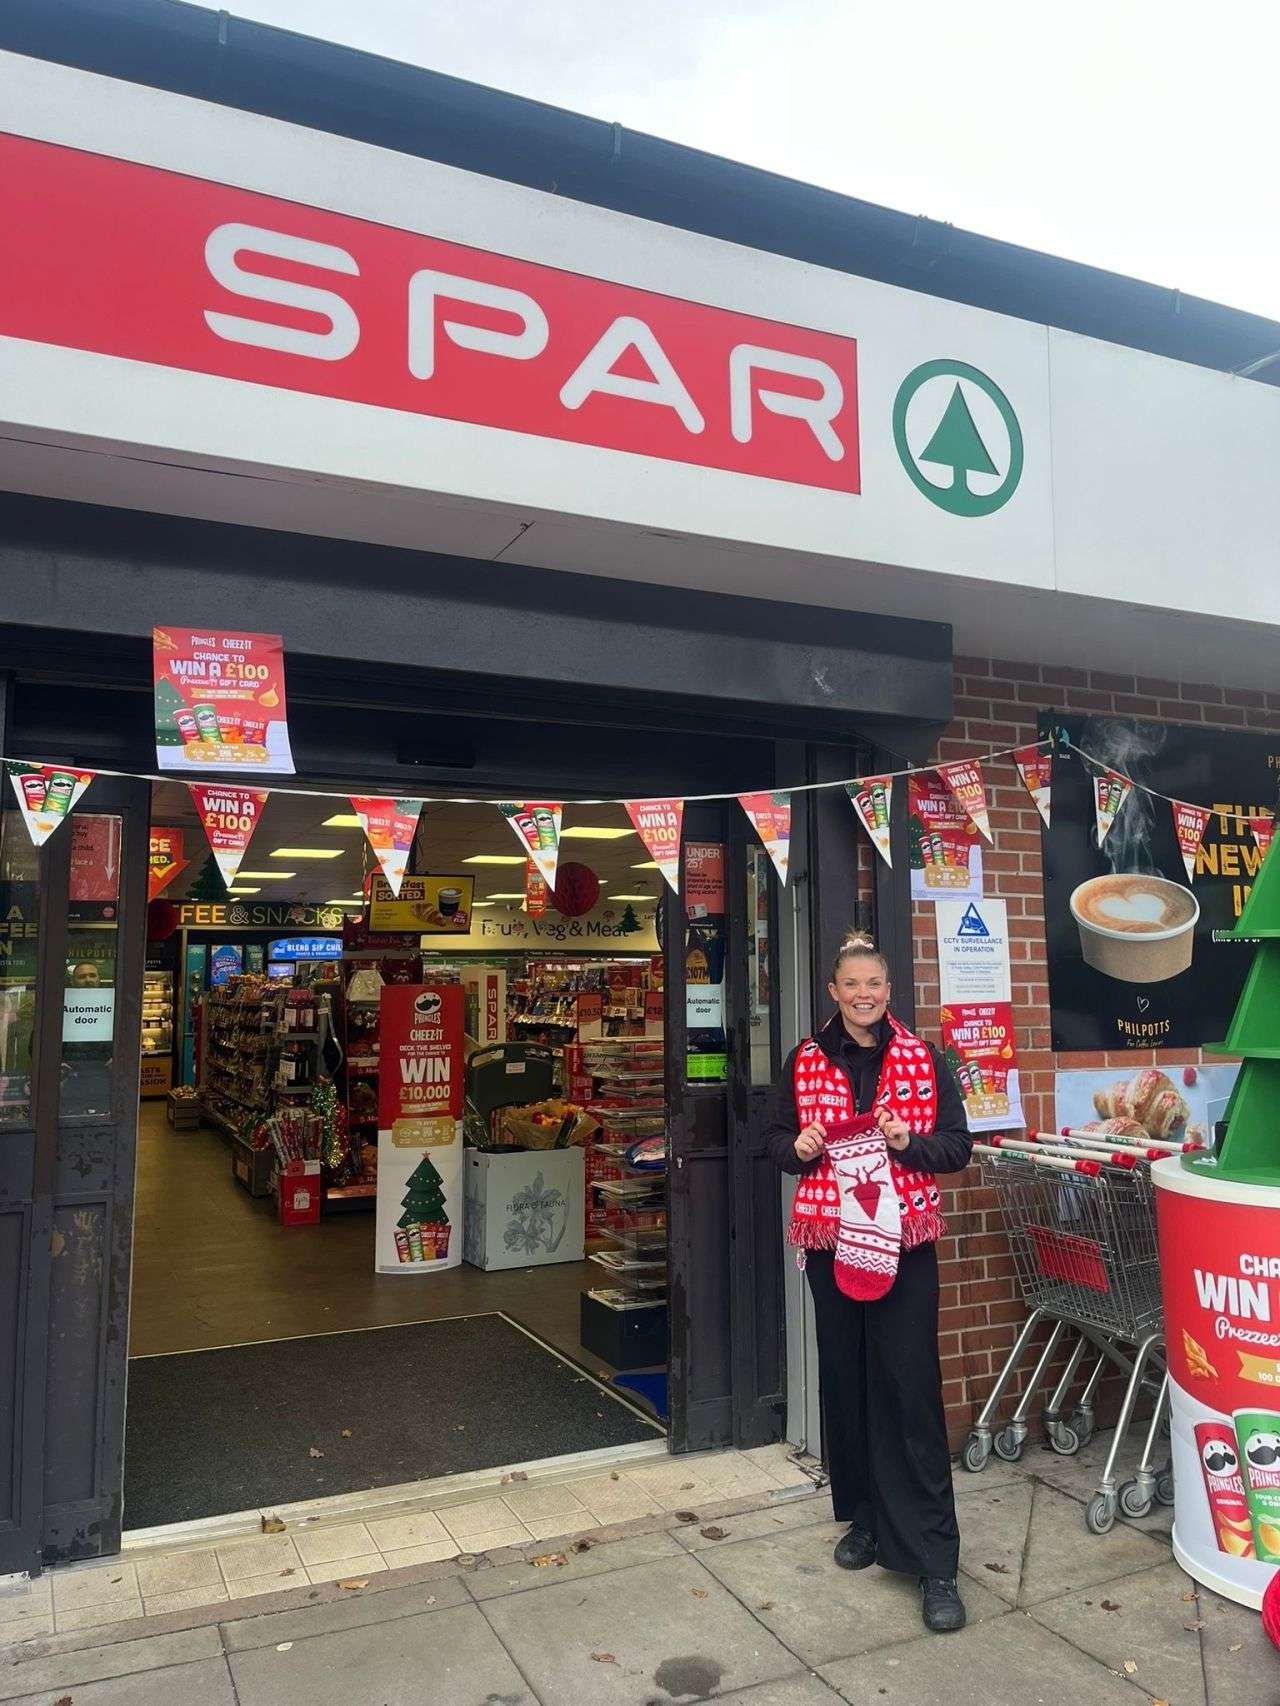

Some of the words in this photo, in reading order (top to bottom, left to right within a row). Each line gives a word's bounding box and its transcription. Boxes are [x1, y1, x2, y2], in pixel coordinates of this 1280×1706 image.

[204, 222, 845, 462] SPAR
[193, 652, 229, 662] CHANCE
[232, 654, 245, 663] TO
[169, 659, 206, 676] WIN
[209, 662, 222, 677] A
[225, 663, 269, 680] £100
[947, 773, 971, 788] WIN
[970, 770, 980, 783] A
[207, 789, 237, 799] CHANCE
[239, 792, 250, 800] TO
[955, 784, 982, 799] £100
[202, 796, 239, 814] WIN
[242, 801, 255, 816] A
[917, 799, 938, 812] WIN
[939, 801, 947, 813] A
[205, 812, 252, 832] £100
[637, 813, 665, 828] WIN
[667, 813, 678, 825] A
[1178, 813, 1195, 829] WIN
[1196, 817, 1204, 831] A
[643, 828, 677, 844] £100
[1178, 825, 1200, 842] £100
[687, 847, 720, 859] UNDER
[6, 904, 24, 921] A
[175, 904, 227, 924] FEE
[229, 904, 250, 925] &
[569, 920, 584, 937] &
[64, 1005, 112, 1014] Automatic
[687, 997, 721, 1005] Automatic
[74, 1016, 98, 1025] door
[414, 1012, 441, 1025] PRINGLES
[487, 988, 498, 1039] SPAR
[409, 1028, 444, 1041] CHEEZ-IT
[951, 1027, 972, 1041] WIN
[972, 1027, 980, 1040] A
[981, 1026, 1006, 1039] £100
[1117, 1019, 1171, 1037] PHILPOTTS
[399, 1057, 451, 1084] WIN
[399, 1085, 451, 1101] £10,000
[506, 1201, 531, 1213] FLORA
[539, 1199, 567, 1210] FAUNA
[1193, 1268, 1271, 1322] WIN
[1215, 1316, 1280, 1347] Prezzee
[1206, 1473, 1246, 1496] PRINGLES
